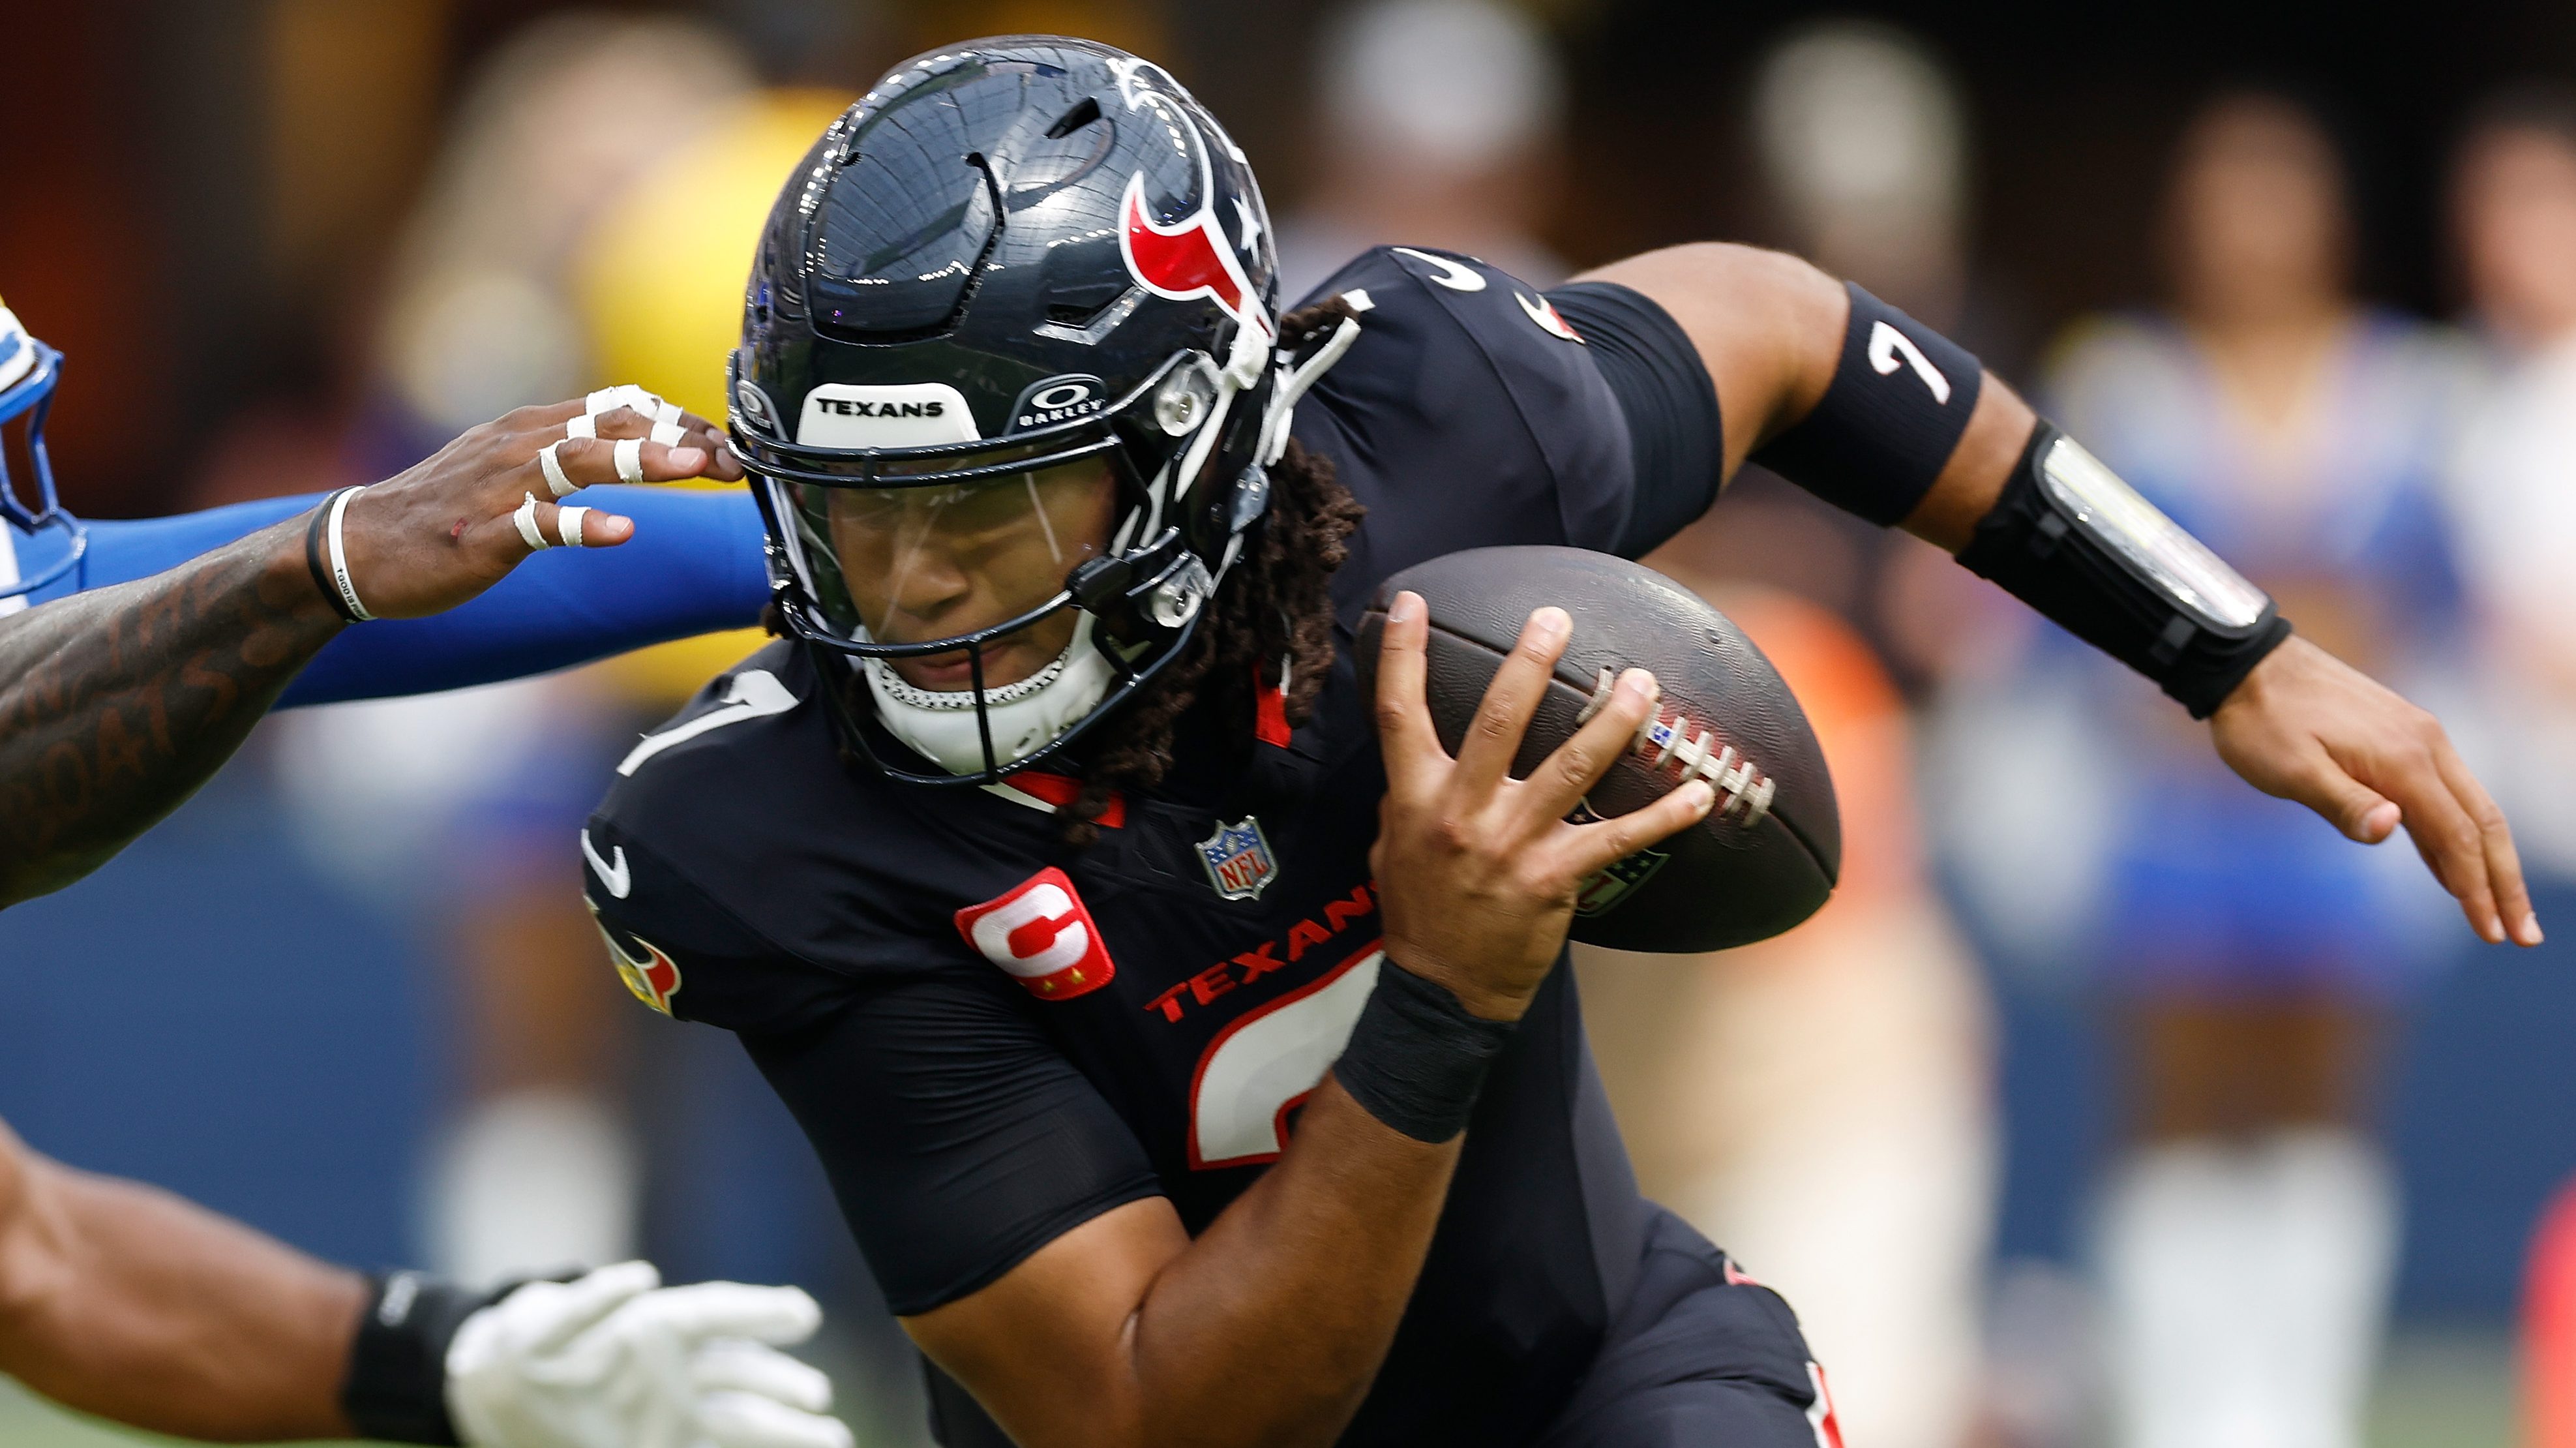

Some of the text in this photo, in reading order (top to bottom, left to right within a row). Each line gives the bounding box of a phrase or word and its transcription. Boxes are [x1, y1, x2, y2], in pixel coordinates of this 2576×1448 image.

[1868, 320, 1951, 404] 7
[816, 399, 943, 417] TEXANS
[1019, 399, 1105, 426] OAKLEY
[338, 575, 350, 595] GOD
[617, 670, 800, 776] 7
[1216, 849, 1269, 889] NFL
[971, 883, 1088, 977] C
[1143, 879, 1378, 1023] TEXAN
